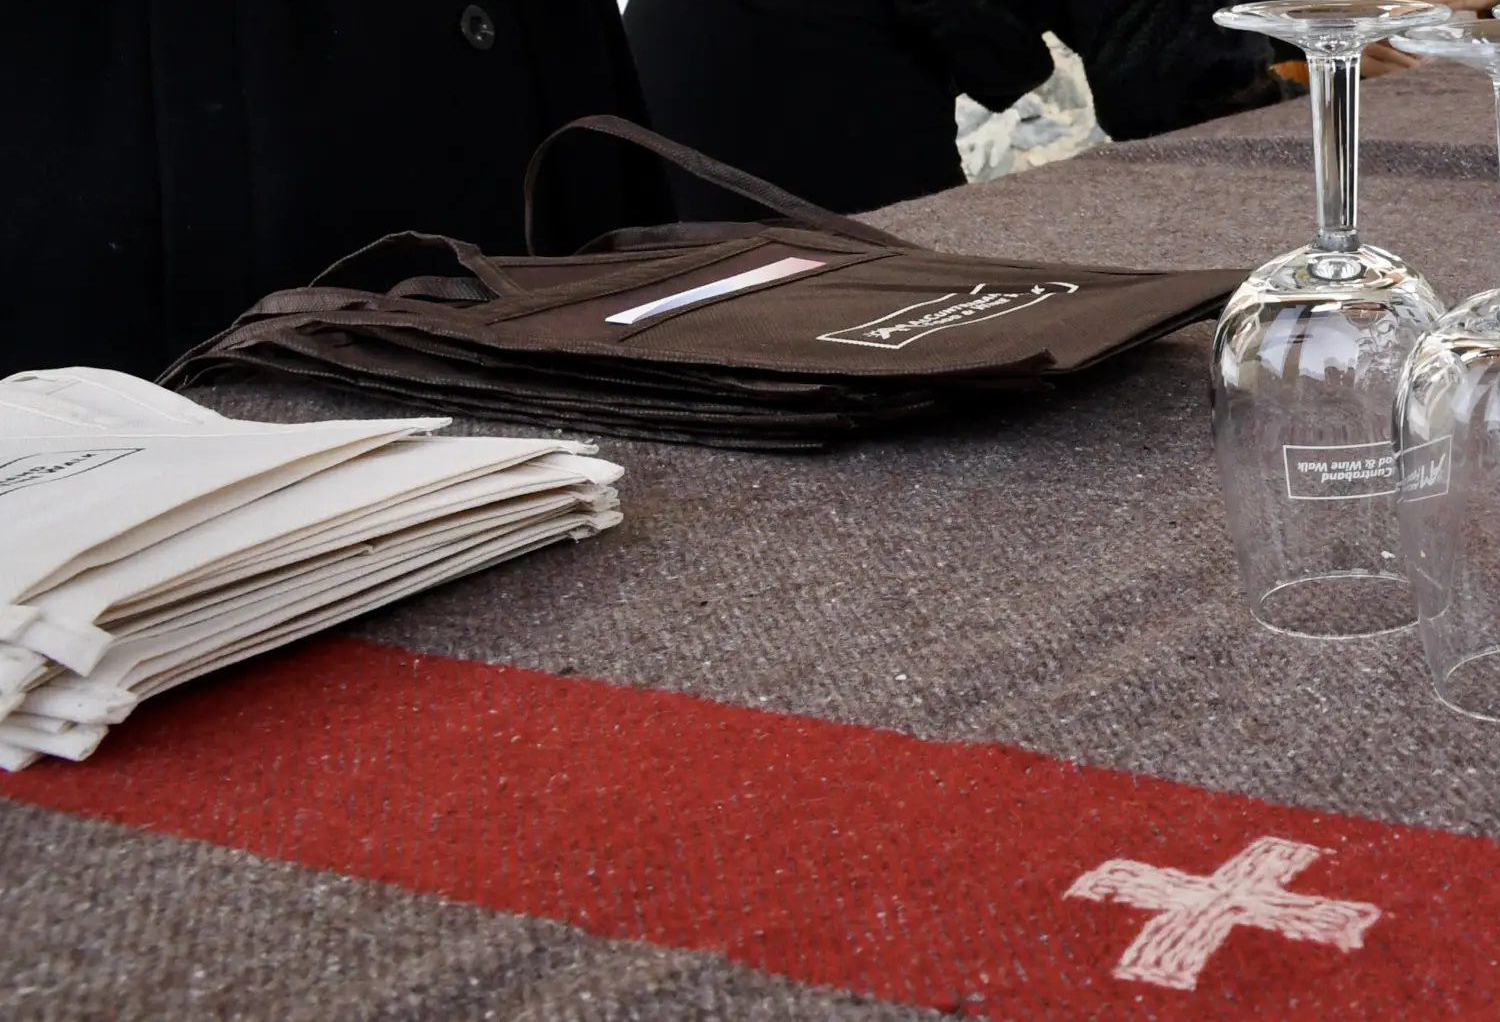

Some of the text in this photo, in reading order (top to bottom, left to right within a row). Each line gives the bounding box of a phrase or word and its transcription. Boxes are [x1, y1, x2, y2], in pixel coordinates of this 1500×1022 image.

[1297, 462, 1328, 473] Walk
[1330, 460, 1362, 472] Wine
[1365, 458, 1374, 468] &
[1321, 467, 1393, 483] Cuntraband
